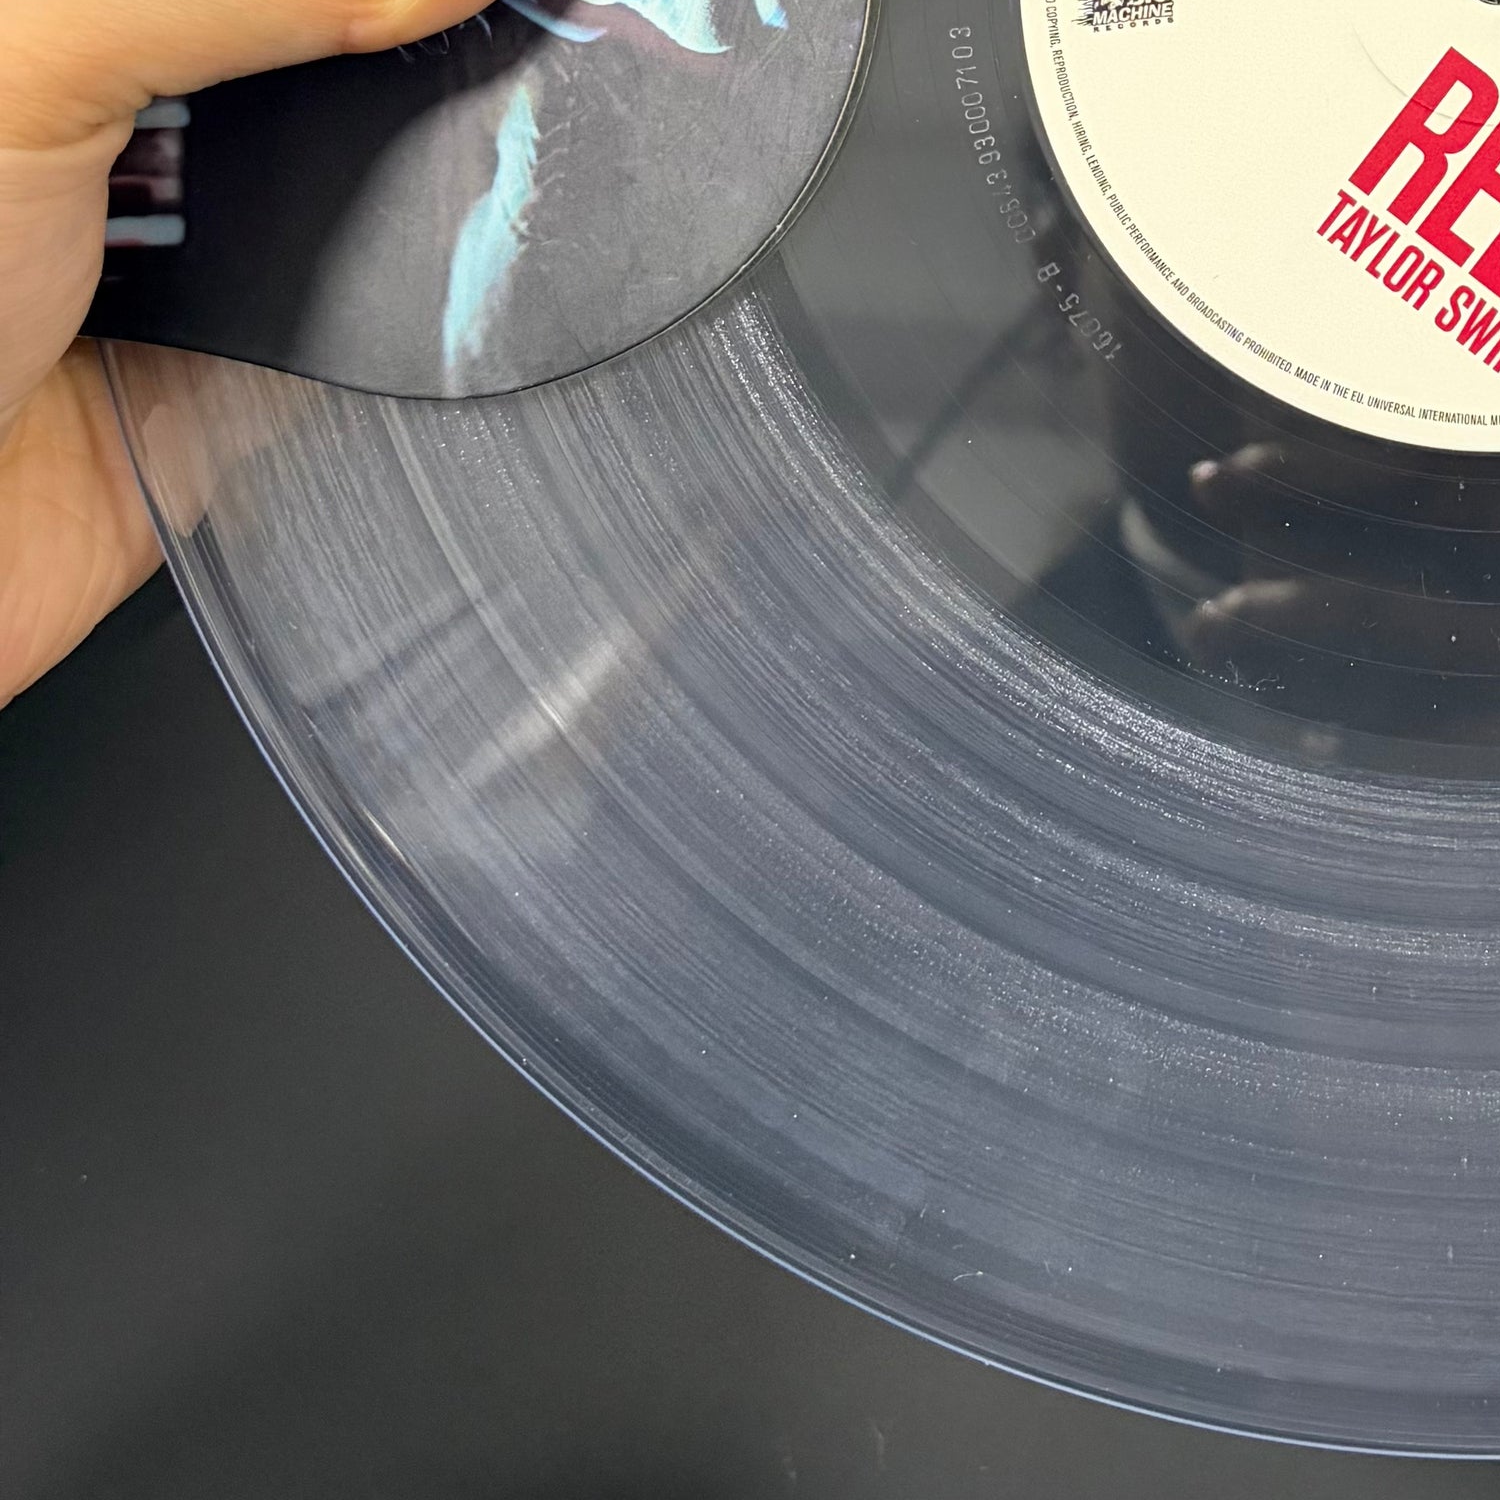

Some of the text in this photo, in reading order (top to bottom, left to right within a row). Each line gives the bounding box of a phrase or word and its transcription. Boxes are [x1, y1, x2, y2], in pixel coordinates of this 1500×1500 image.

[1044, 5, 1062, 49] COPYING,
[1091, 0, 1174, 27] MACHINE
[1093, 17, 1175, 33] RECORDS
[1050, 48, 1080, 122] REPRODUCTION,
[1069, 119, 1094, 156] HIRING,
[1083, 153, 1114, 197] LENDING,
[1104, 192, 1132, 226] PUBLIC
[1124, 221, 1176, 282] PERFORMANCE
[1316, 189, 1446, 311] TAYLOR
[1169, 275, 1191, 297] AND
[1184, 290, 1246, 344] BROADCASTING
[1240, 335, 1296, 375] PROHIBITED.
[1292, 365, 1321, 387] MADE
[1318, 377, 1332, 392] IN
[1329, 382, 1351, 399] THE
[1349, 389, 1367, 405] EU.
[1365, 394, 1417, 418] UNIVERSAL
[1417, 406, 1488, 426] INTERNATIONAL
